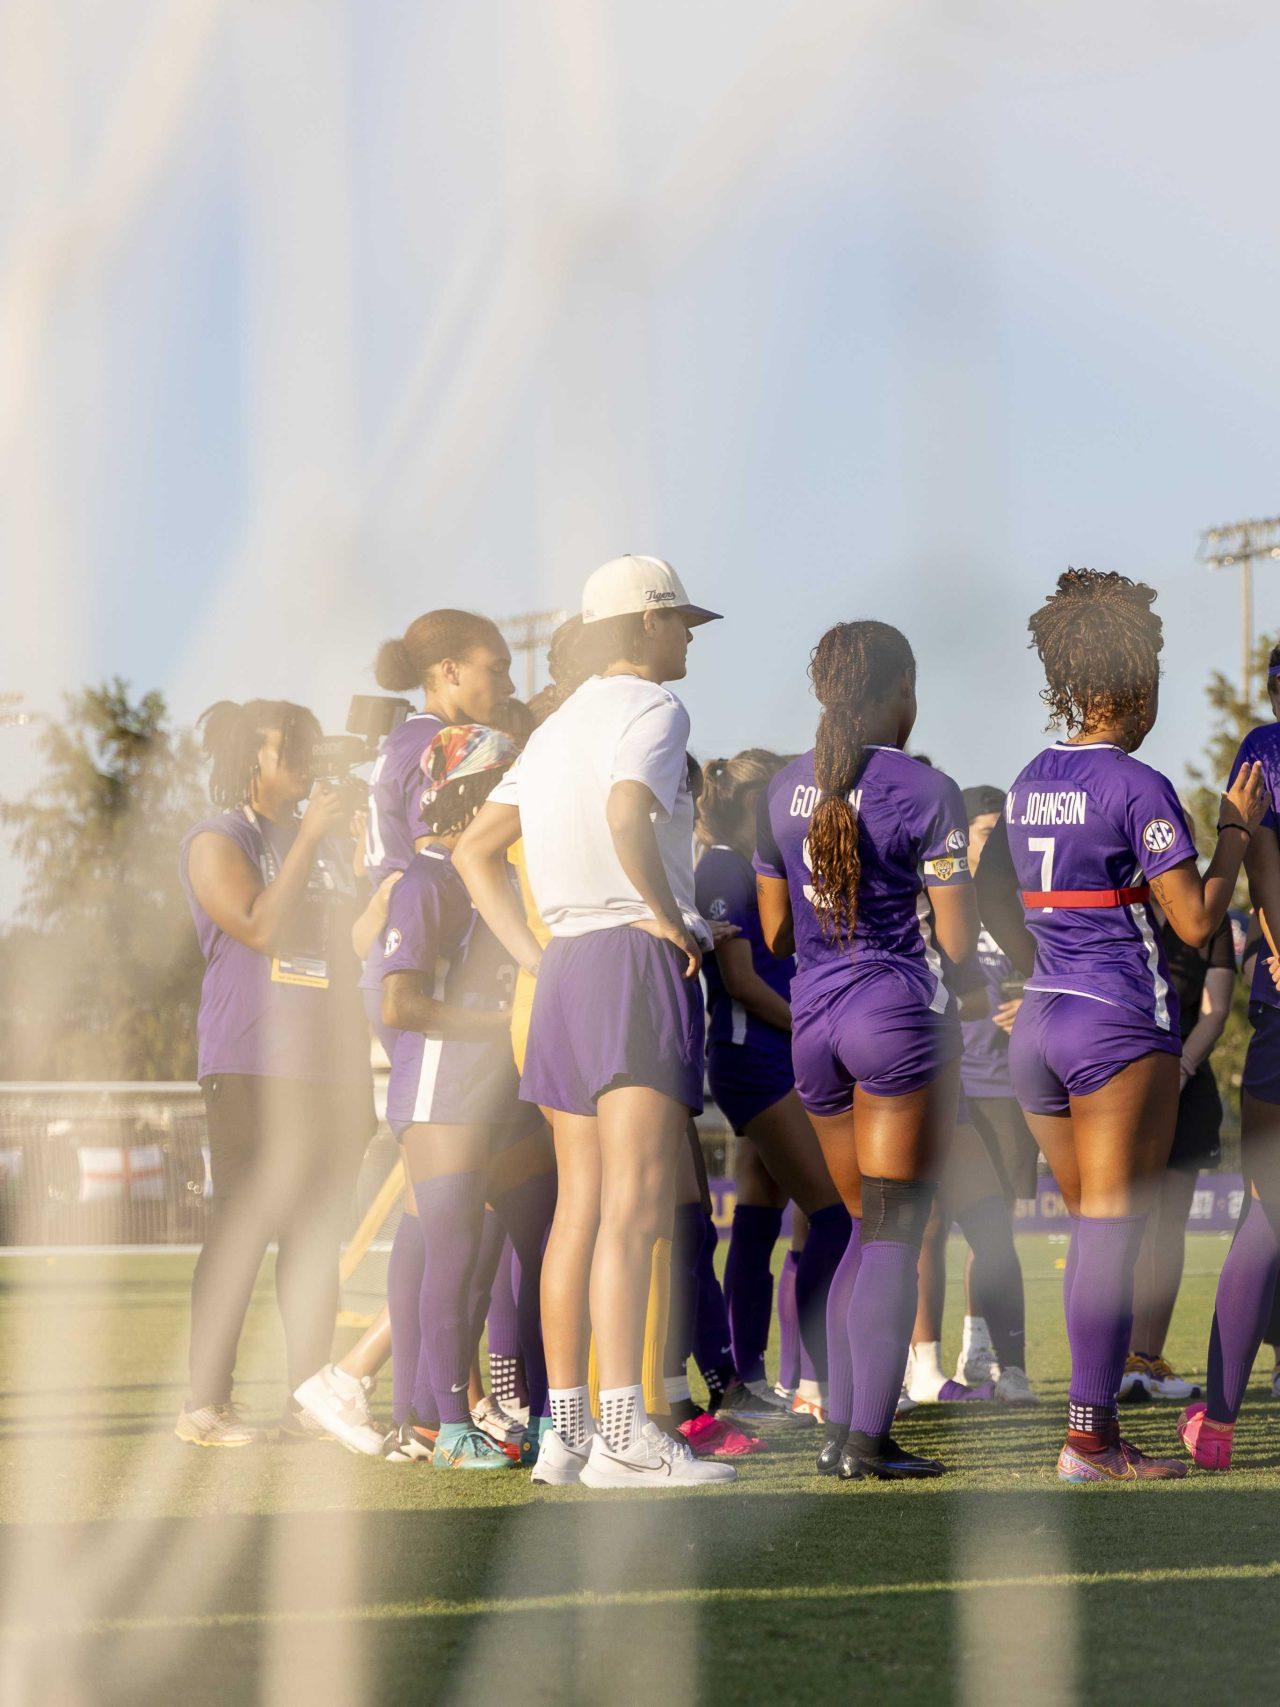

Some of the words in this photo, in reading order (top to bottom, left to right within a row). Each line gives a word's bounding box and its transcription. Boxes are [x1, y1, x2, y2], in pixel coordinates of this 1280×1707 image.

[645, 589, 676, 602] Tigers
[1021, 791, 1087, 826] JOHNSON
[1144, 820, 1174, 852] SEC
[1028, 837, 1056, 914] 7
